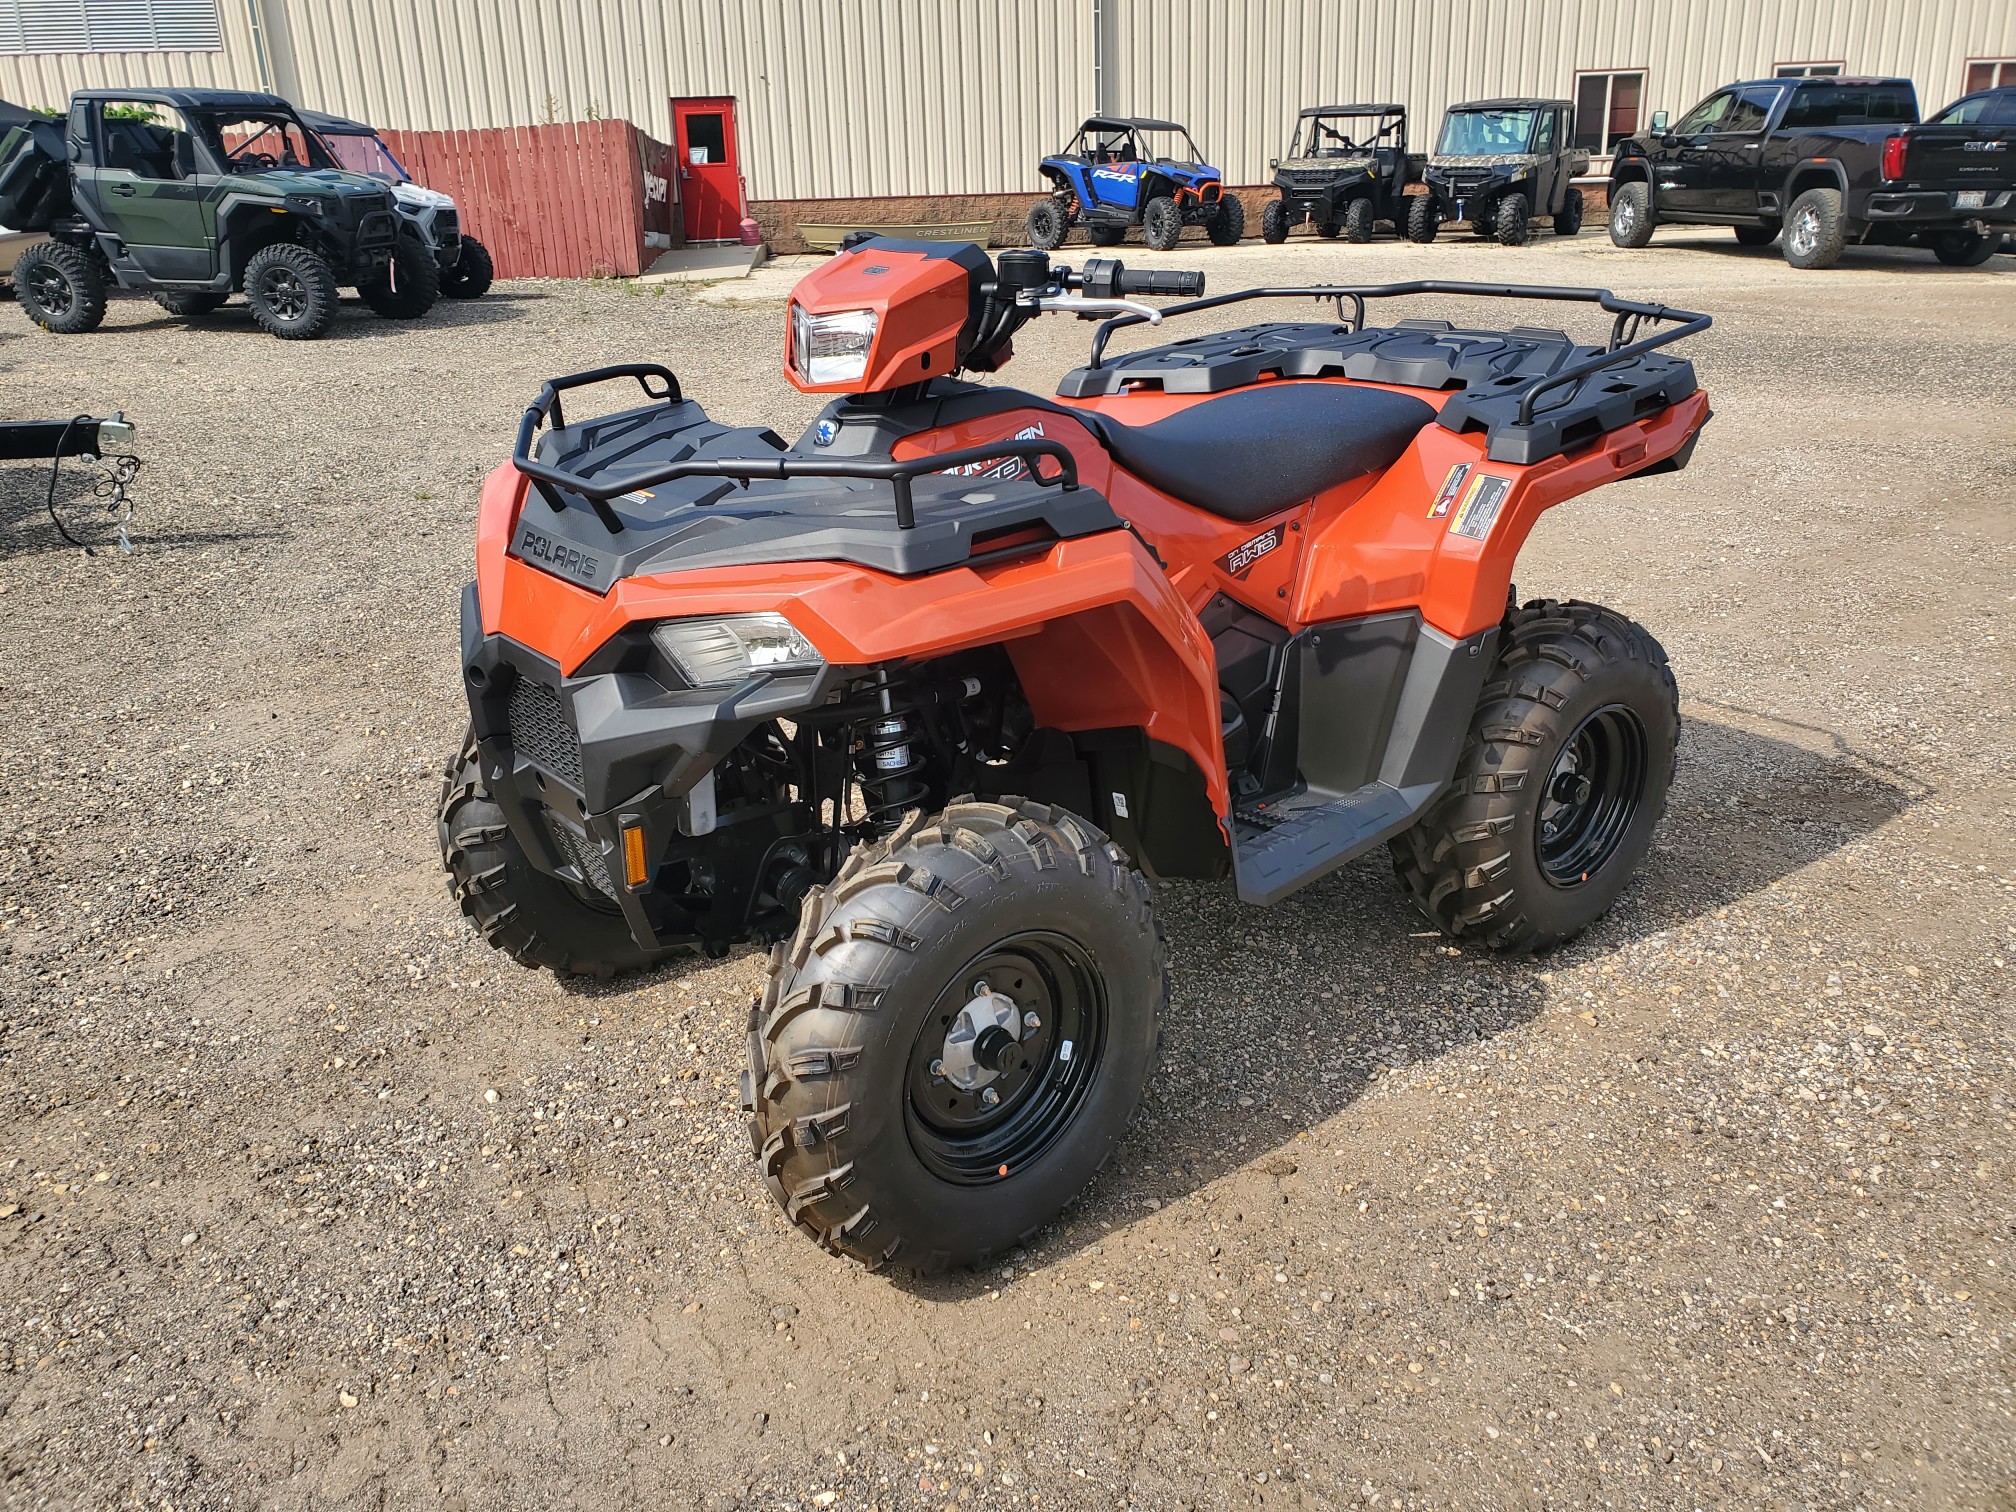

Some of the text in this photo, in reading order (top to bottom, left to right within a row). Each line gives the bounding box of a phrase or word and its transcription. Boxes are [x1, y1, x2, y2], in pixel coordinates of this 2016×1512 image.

[1964, 141, 2007, 151] GMC
[1092, 169, 1137, 184] RZR
[916, 226, 987, 237] CRESTLINER
[521, 530, 599, 580] POLARIS
[1229, 535, 1277, 573] AWD
